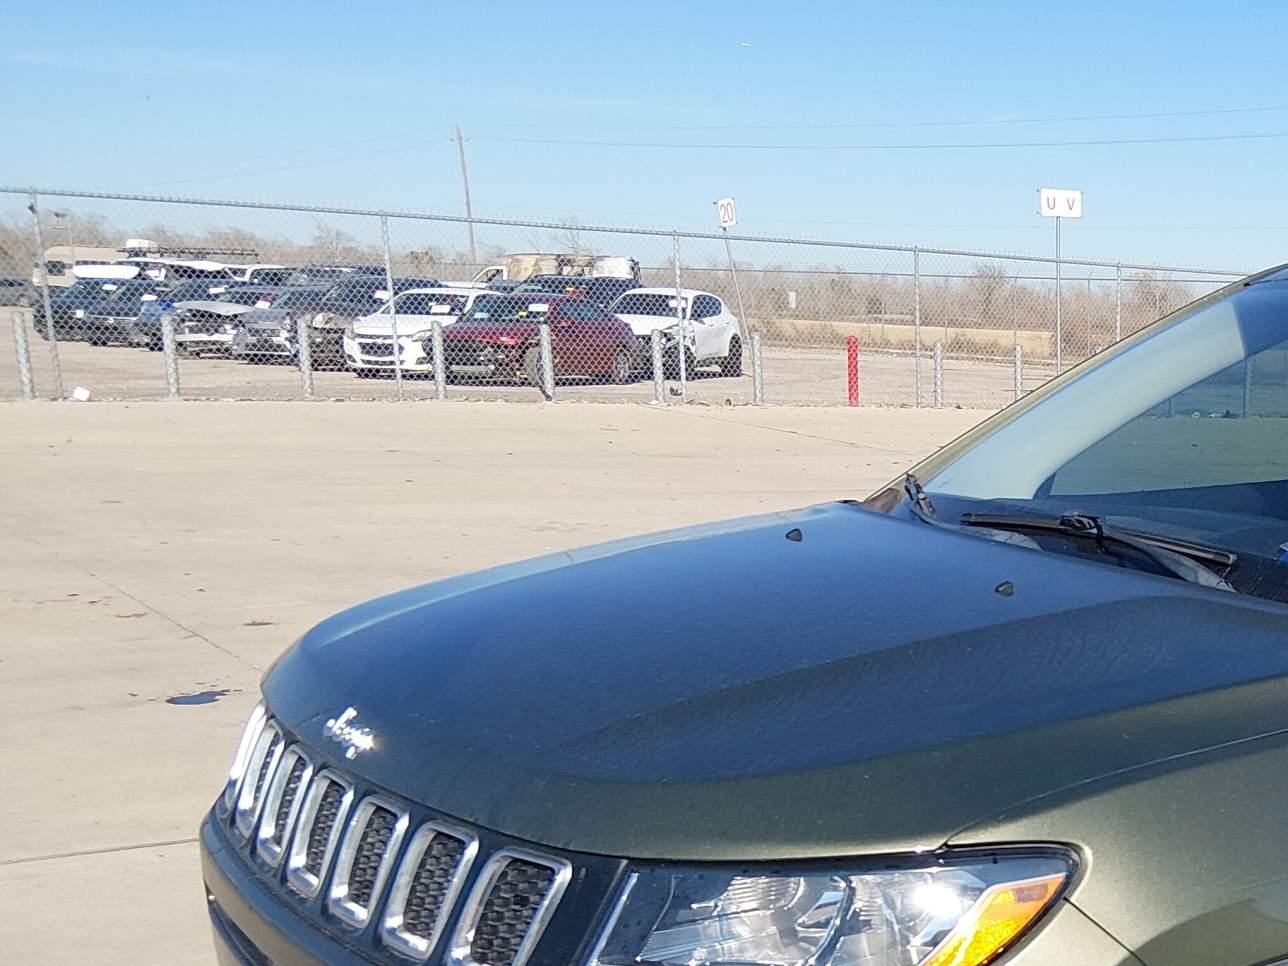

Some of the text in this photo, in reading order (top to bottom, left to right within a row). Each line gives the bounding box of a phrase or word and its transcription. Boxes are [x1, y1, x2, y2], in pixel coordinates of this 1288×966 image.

[720, 202, 734, 223] 20
[1046, 196, 1076, 211] U V
